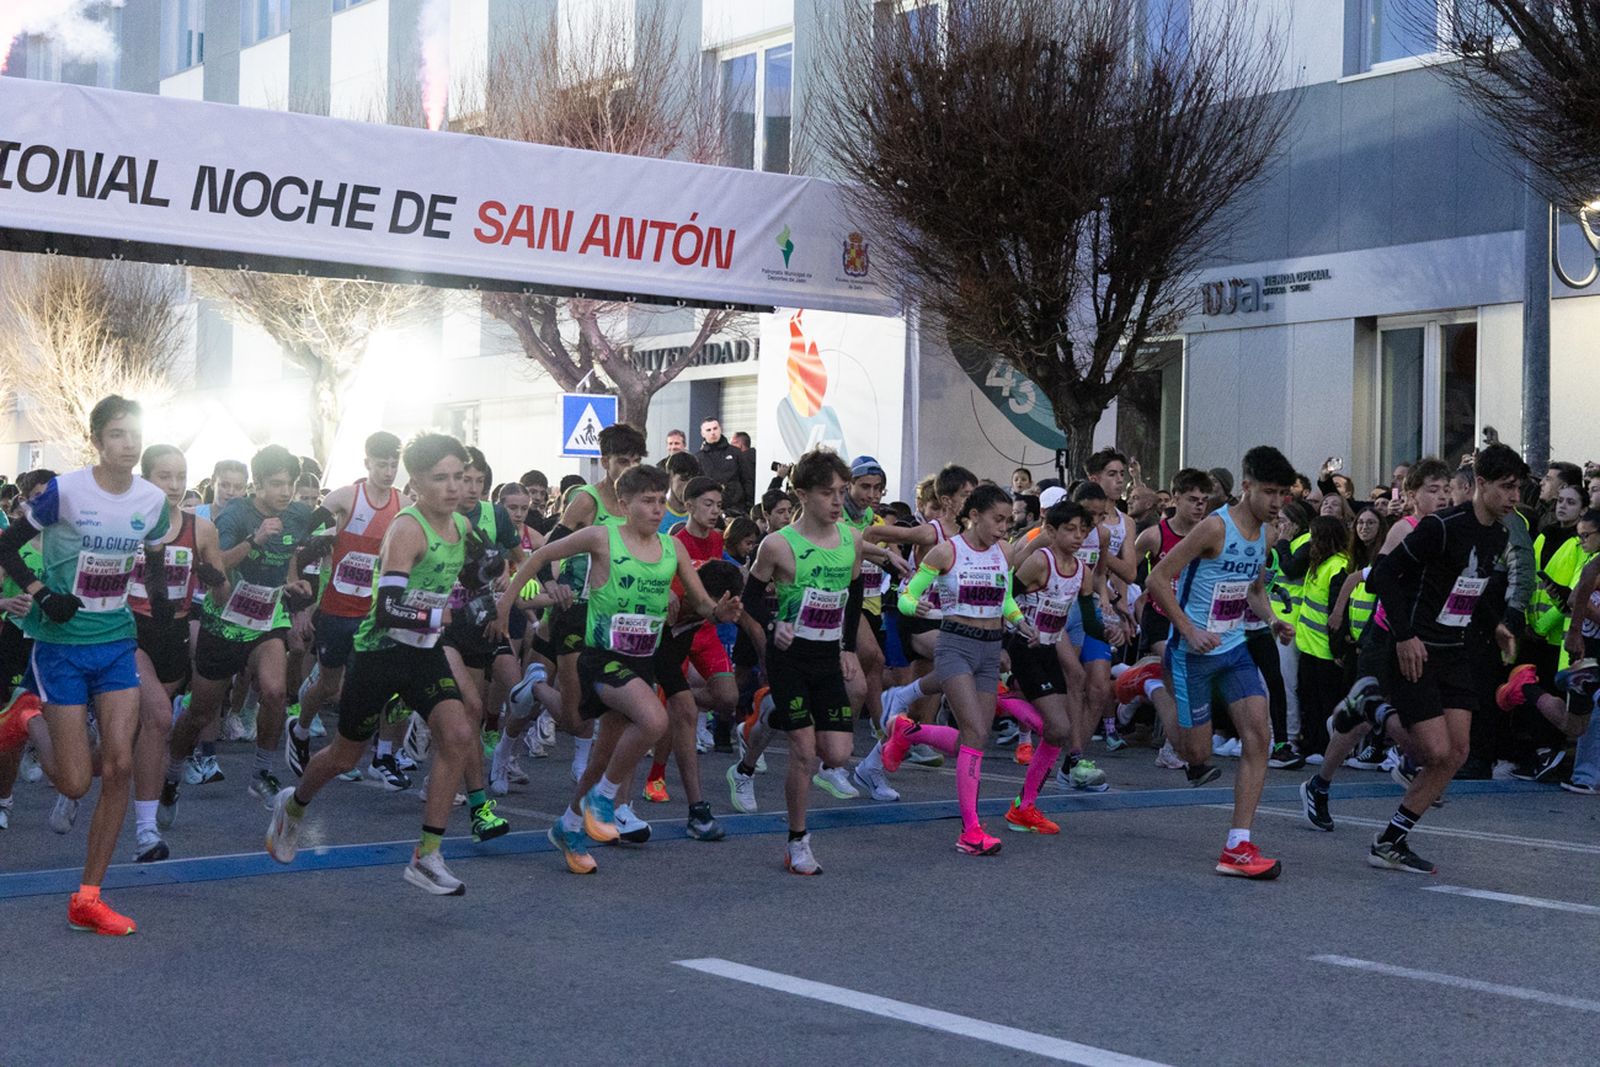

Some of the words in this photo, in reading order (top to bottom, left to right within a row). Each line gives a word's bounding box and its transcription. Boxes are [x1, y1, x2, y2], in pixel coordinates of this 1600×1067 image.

[190, 165, 381, 231] NOCHE
[388, 190, 458, 239] DE
[473, 200, 573, 252] SAN
[578, 211, 736, 270] ANTÓN
[1263, 274, 1295, 287] TIENDA
[1295, 269, 1332, 283] OFICIAL
[953, 623, 985, 639] PRO
